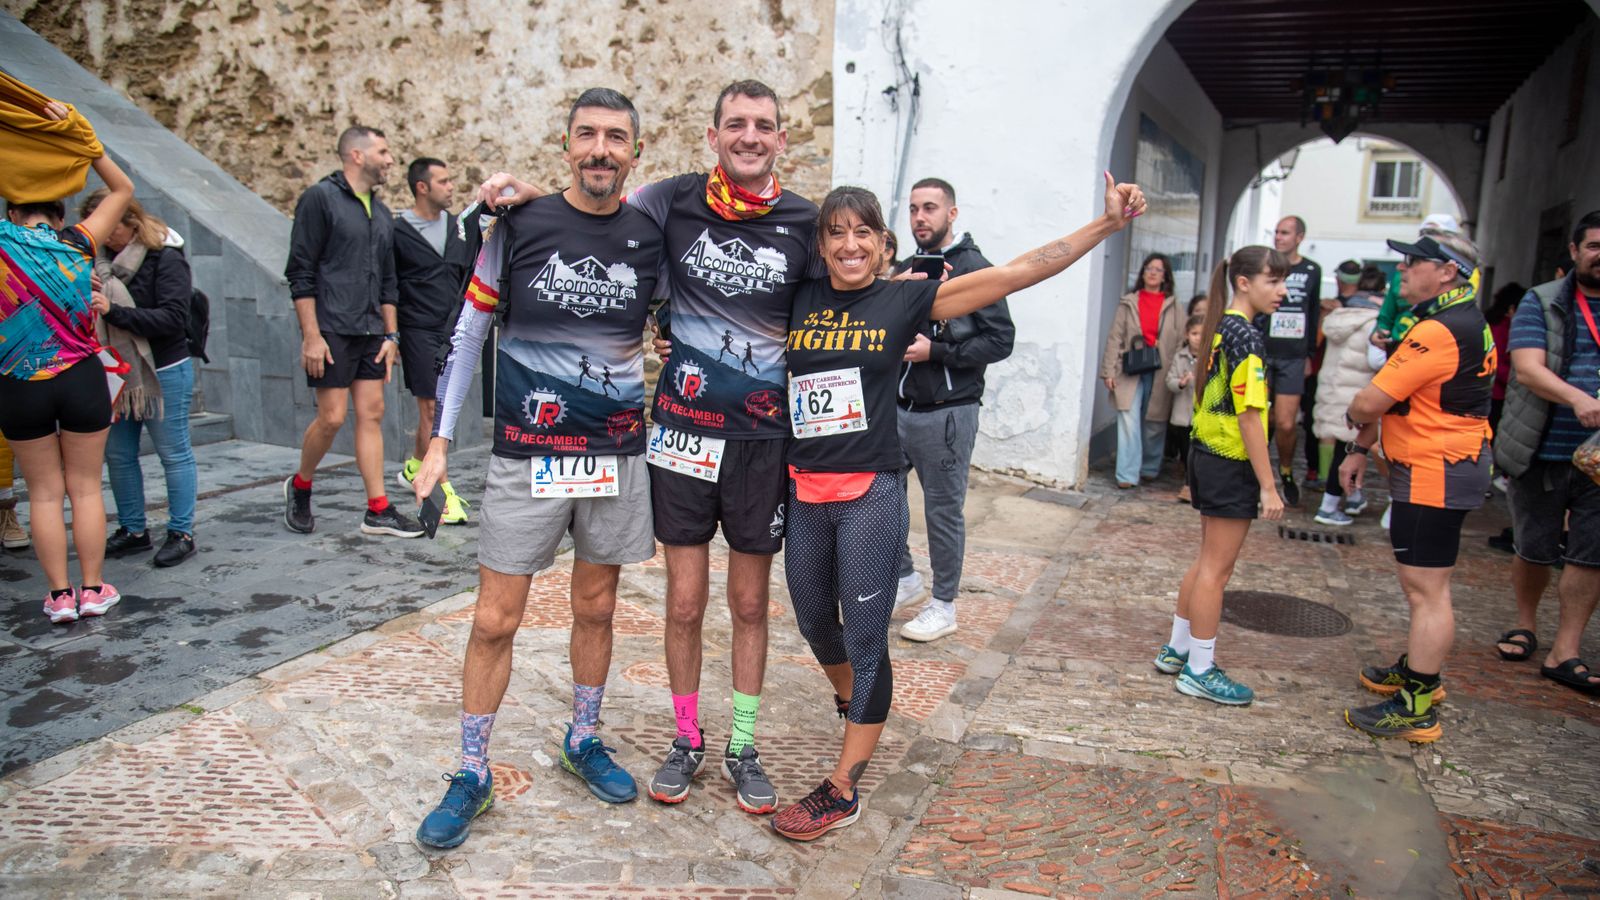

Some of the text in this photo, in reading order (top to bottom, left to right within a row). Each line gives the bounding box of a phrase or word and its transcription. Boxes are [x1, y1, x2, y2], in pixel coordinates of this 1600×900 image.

[692, 267, 770, 291] TRAIL
[706, 281, 752, 295] RUNNING
[543, 292, 624, 308] TRAIL
[559, 304, 606, 314] RUNNING
[797, 379, 815, 392] XIV
[816, 375, 842, 383] CARRERA
[828, 379, 857, 388] ESTRECHO
[657, 396, 725, 423] TU RECAMBIO
[808, 389, 834, 415] 62
[505, 430, 588, 446] TU RECAMBIO
[664, 428, 703, 456] 303
[558, 455, 596, 476] 170
